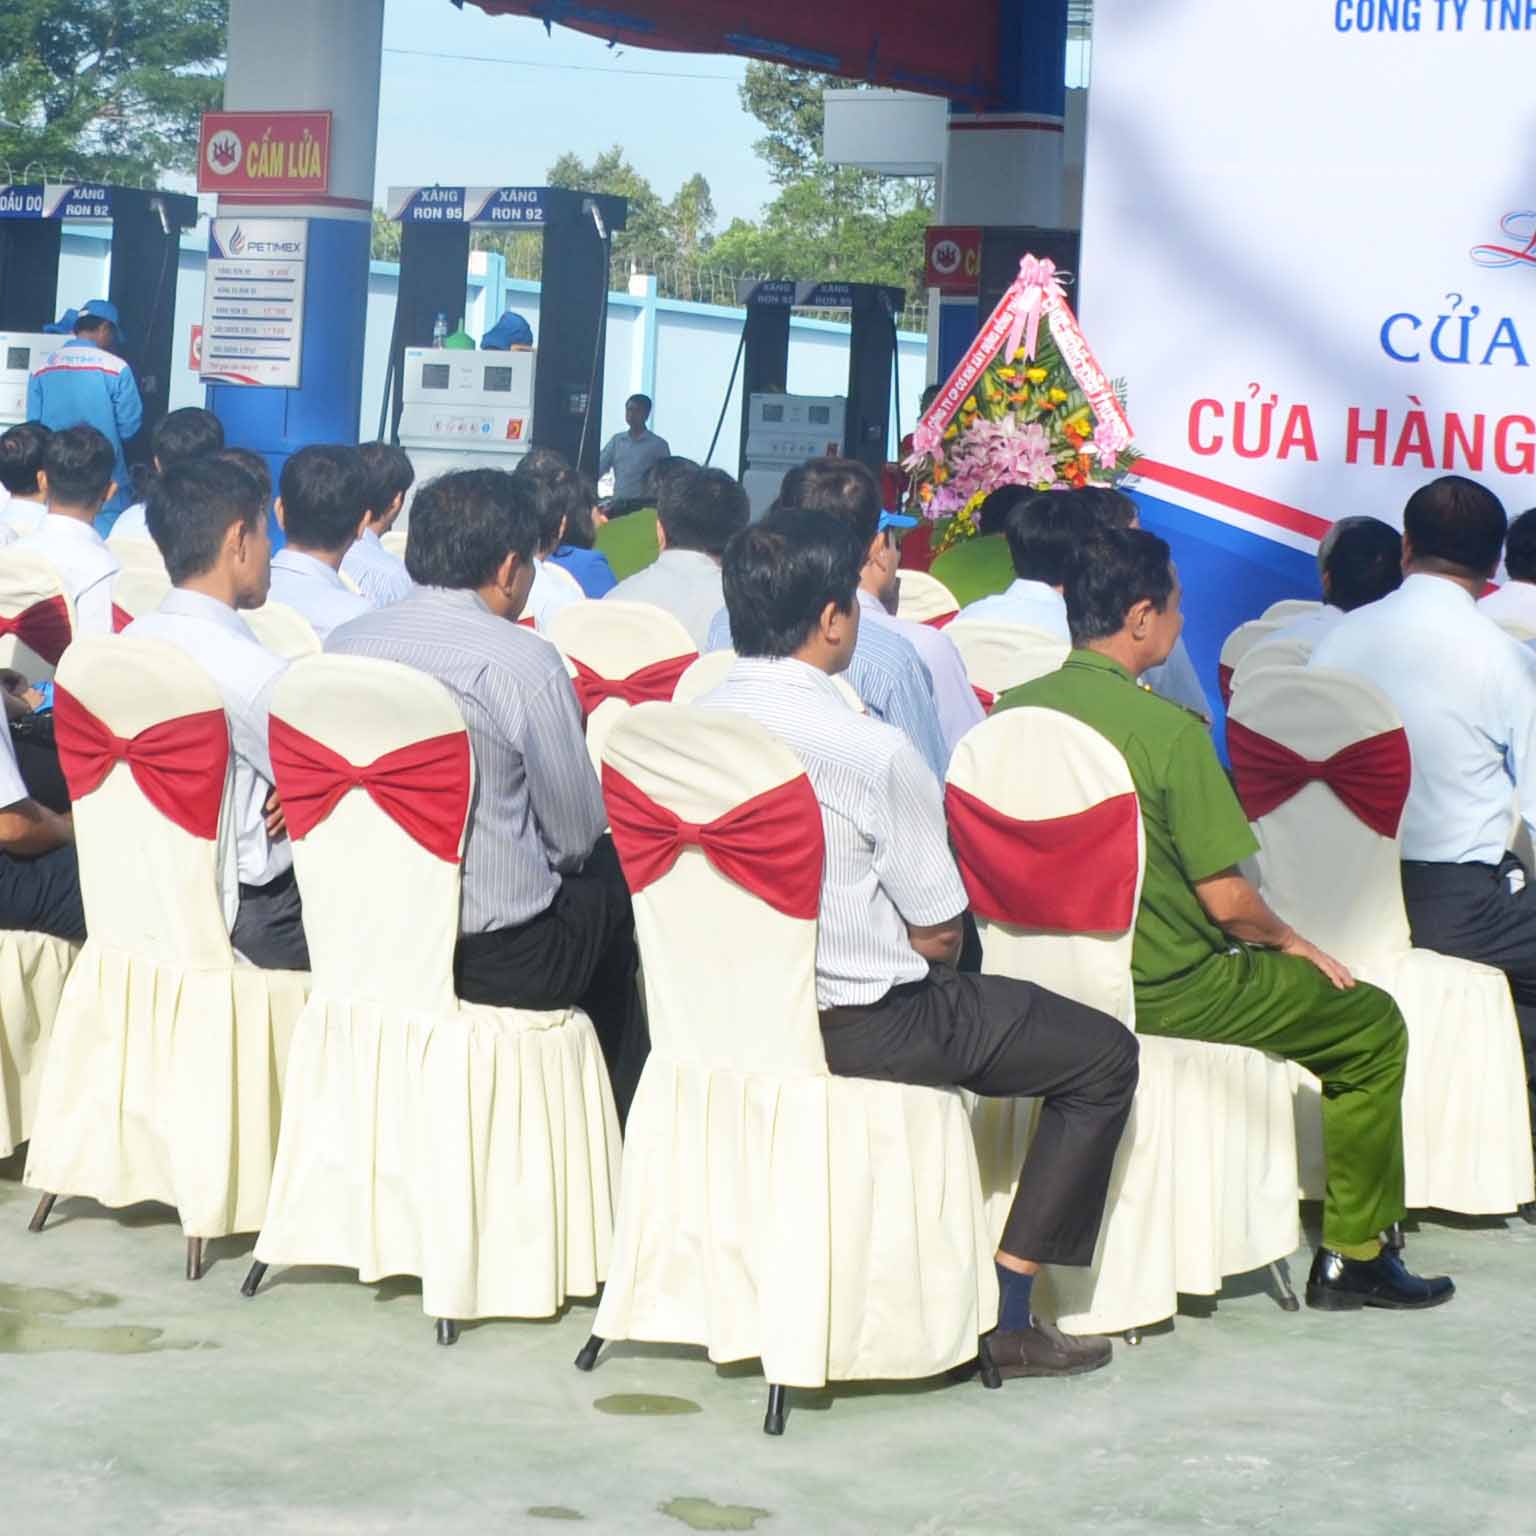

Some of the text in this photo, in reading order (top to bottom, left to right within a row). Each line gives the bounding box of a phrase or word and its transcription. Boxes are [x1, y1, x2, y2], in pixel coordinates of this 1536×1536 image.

[246, 126, 321, 178] CẤM LỬA
[73, 187, 105, 200] XĂNG
[421, 188, 458, 202] XĂNG
[499, 188, 538, 202] XĂNG
[25, 196, 42, 212] DO
[66, 204, 109, 215] RON 92
[414, 208, 462, 219] RON 95
[492, 208, 543, 220] RON 92
[247, 241, 302, 253] PETIMEX
[1379, 292, 1529, 367] CỬA
[1187, 382, 1319, 462] CỬA
[1345, 395, 1536, 475] HÀNG
